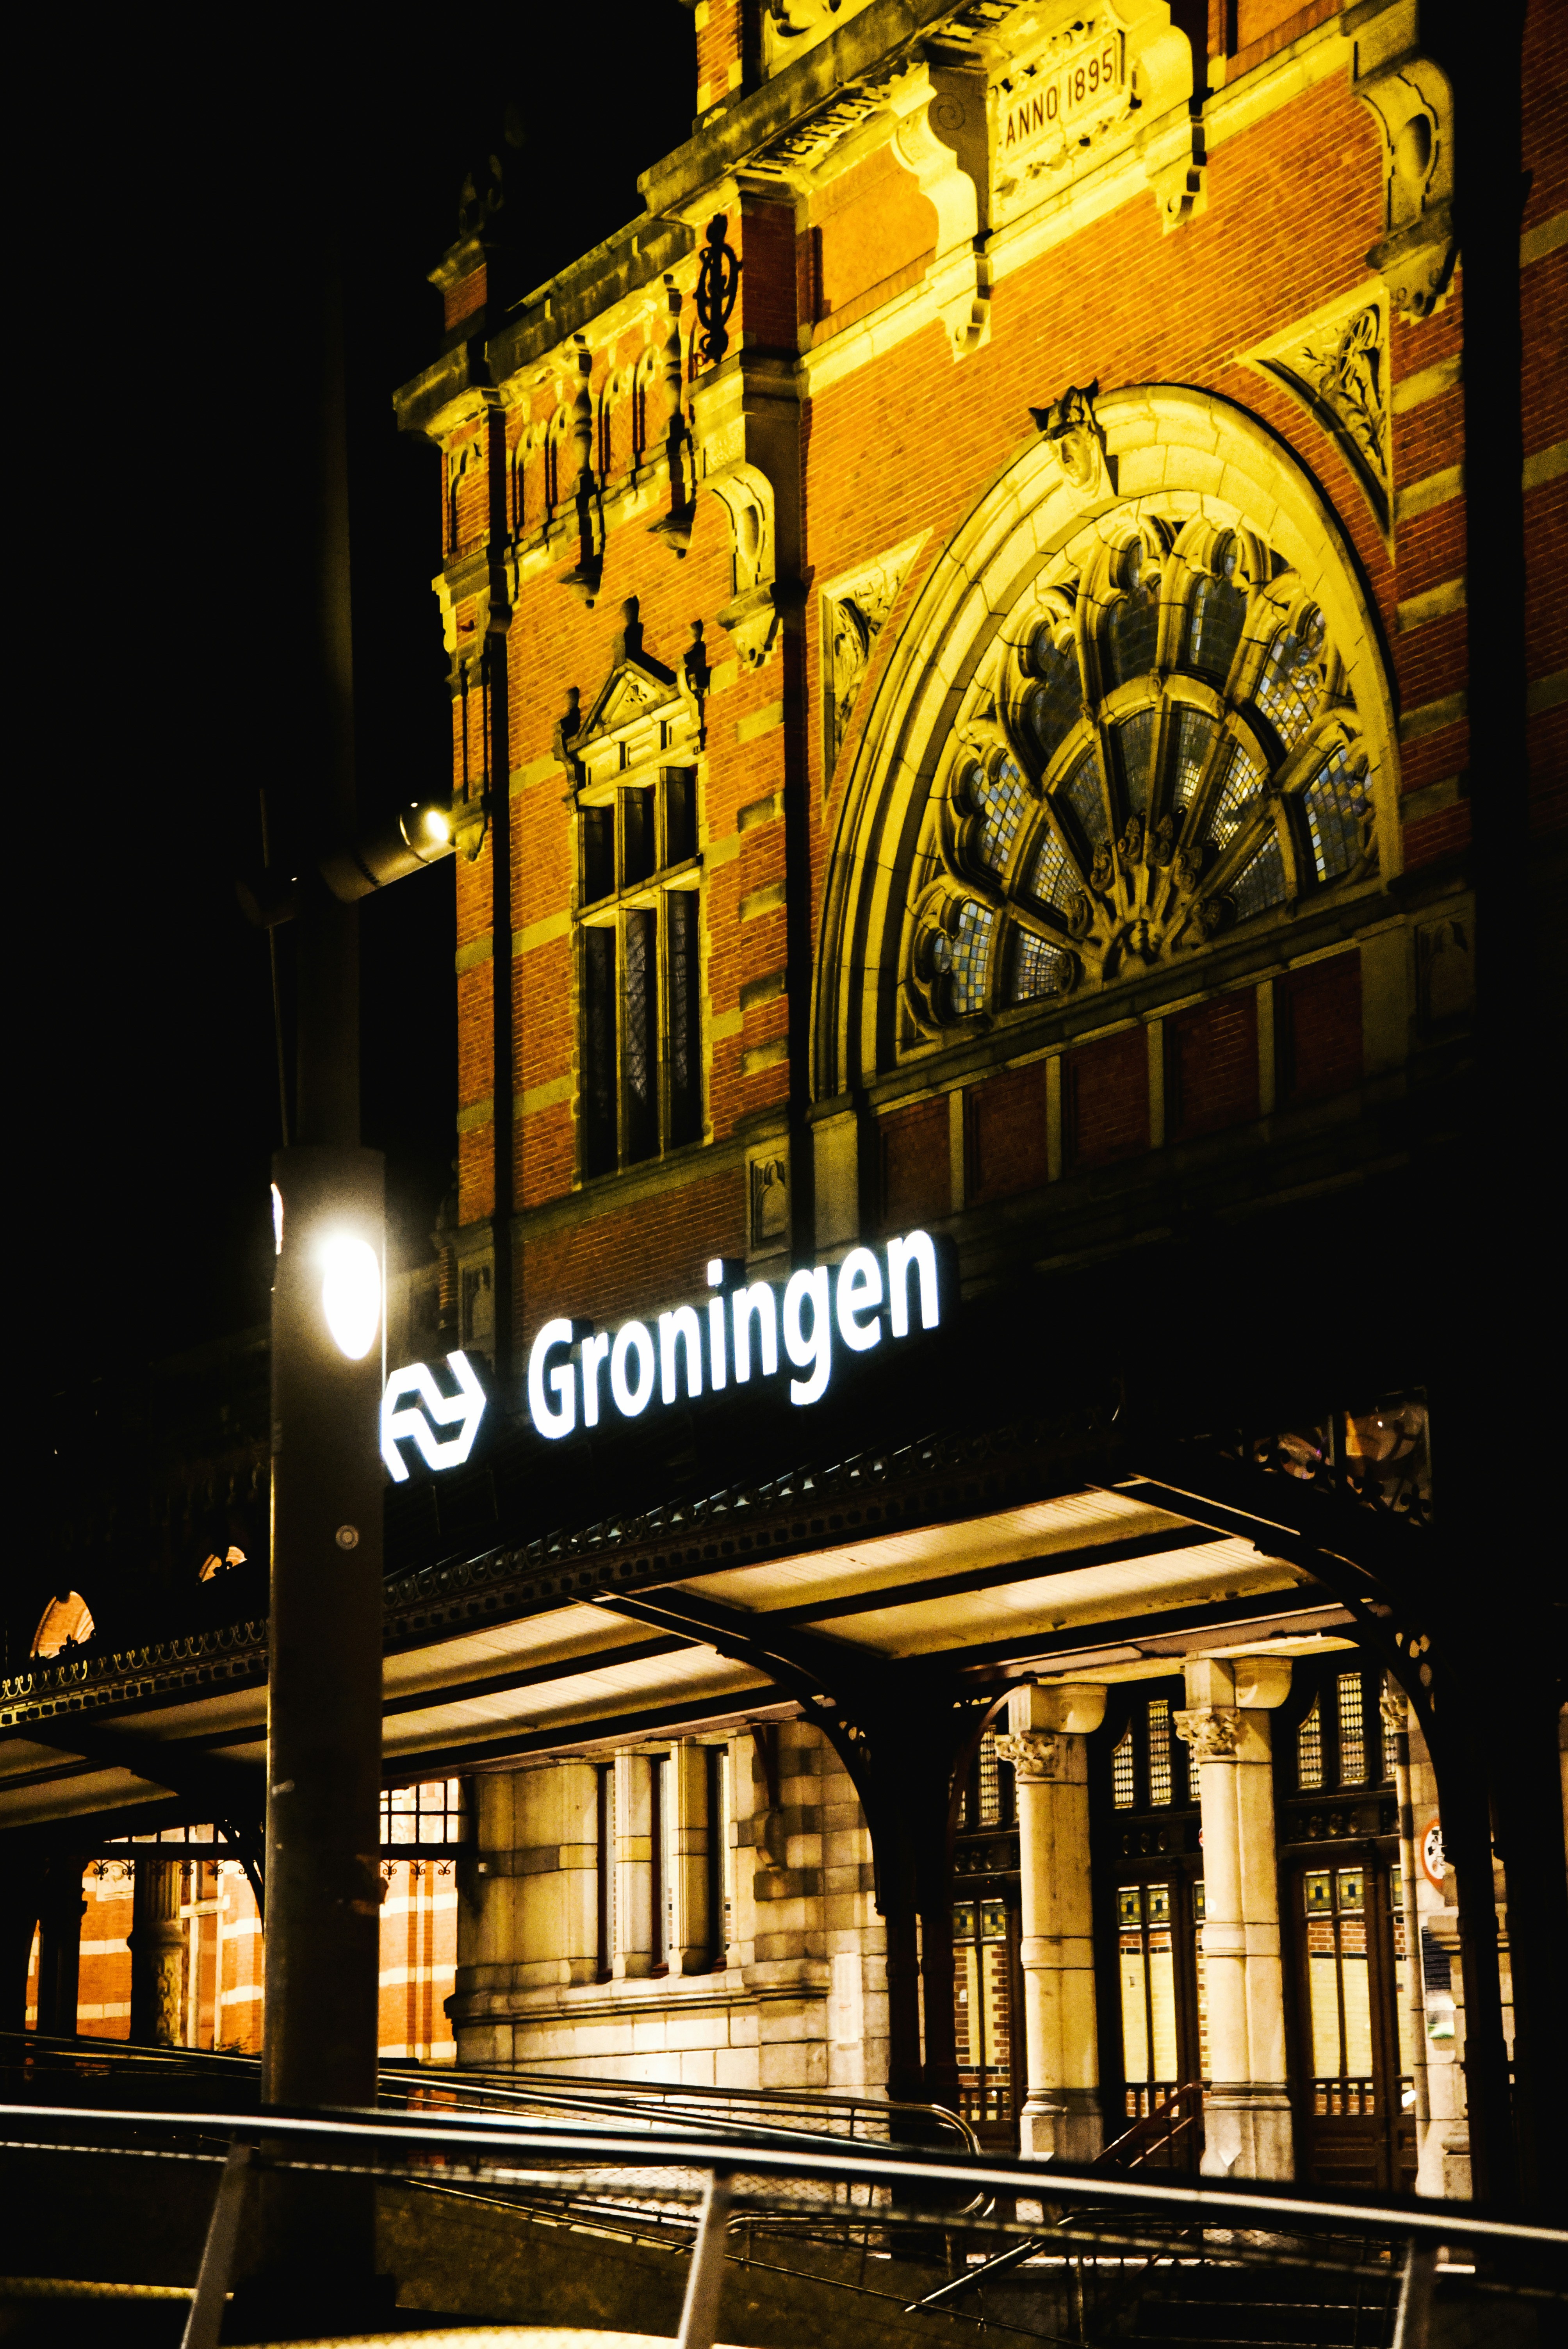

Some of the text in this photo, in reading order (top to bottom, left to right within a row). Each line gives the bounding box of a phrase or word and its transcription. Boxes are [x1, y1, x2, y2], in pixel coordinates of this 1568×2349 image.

[1006, 47, 1113, 149] ANNO 1895
[529, 1230, 938, 1438] Groningen
